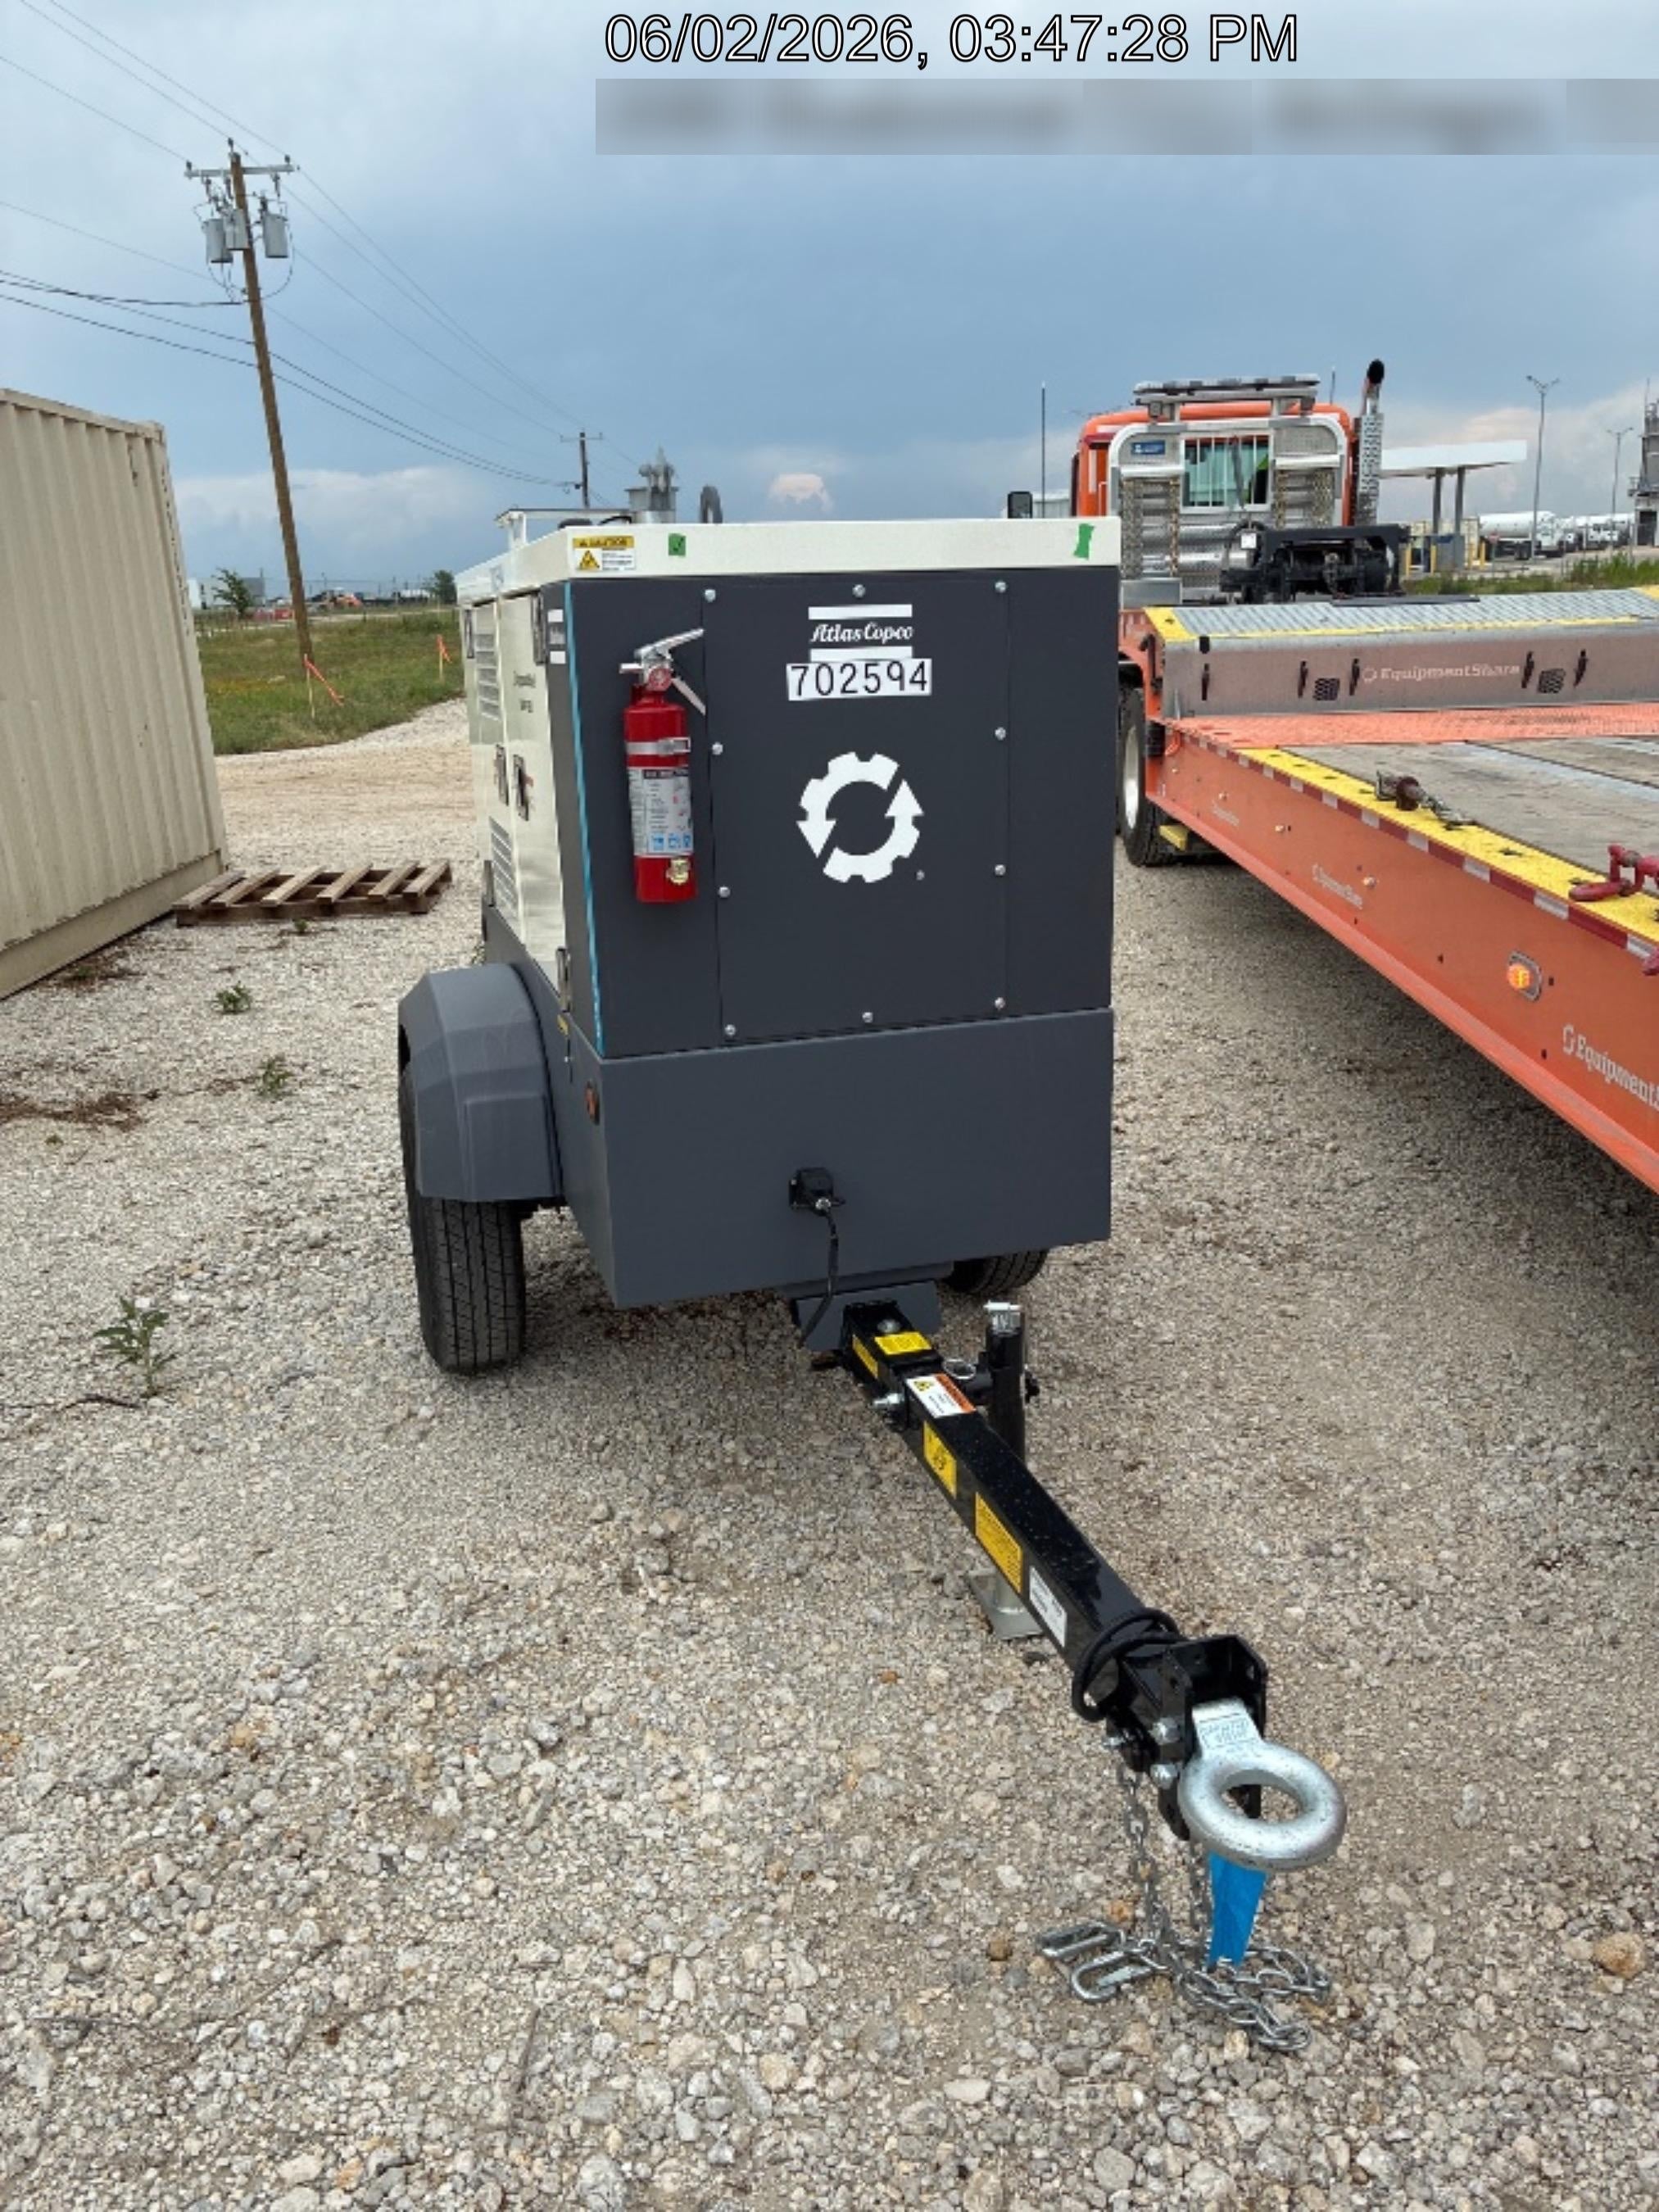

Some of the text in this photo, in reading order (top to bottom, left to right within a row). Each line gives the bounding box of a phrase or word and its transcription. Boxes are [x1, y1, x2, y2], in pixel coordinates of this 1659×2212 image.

[809, 621, 913, 645] Atlas Copco
[790, 660, 927, 697] 702594
[1380, 663, 1521, 682] EquipmentShare
